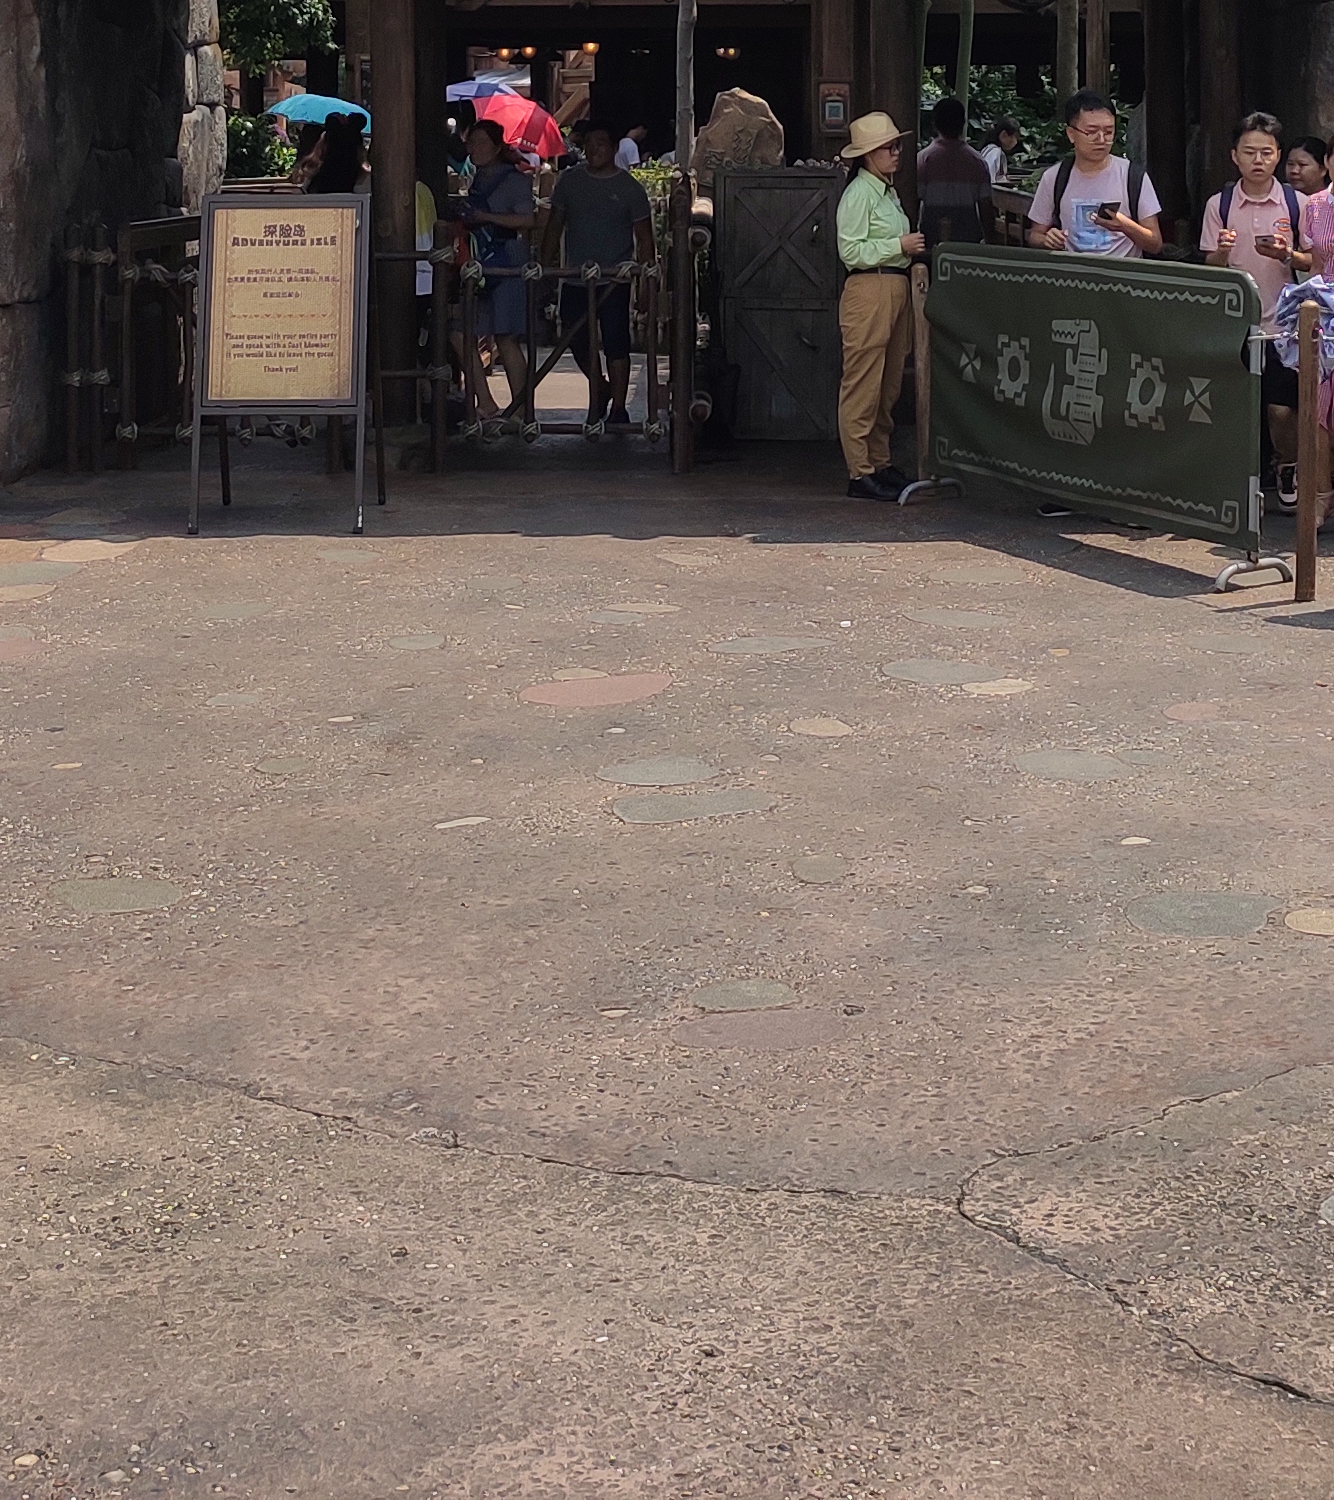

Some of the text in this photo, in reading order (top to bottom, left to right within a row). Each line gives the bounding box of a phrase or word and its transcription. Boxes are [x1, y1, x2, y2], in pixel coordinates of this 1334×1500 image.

[263, 223, 306, 238] 探险岛
[232, 235, 337, 247] ADVENTURE ISLE
[263, 365, 284, 373] Thank
